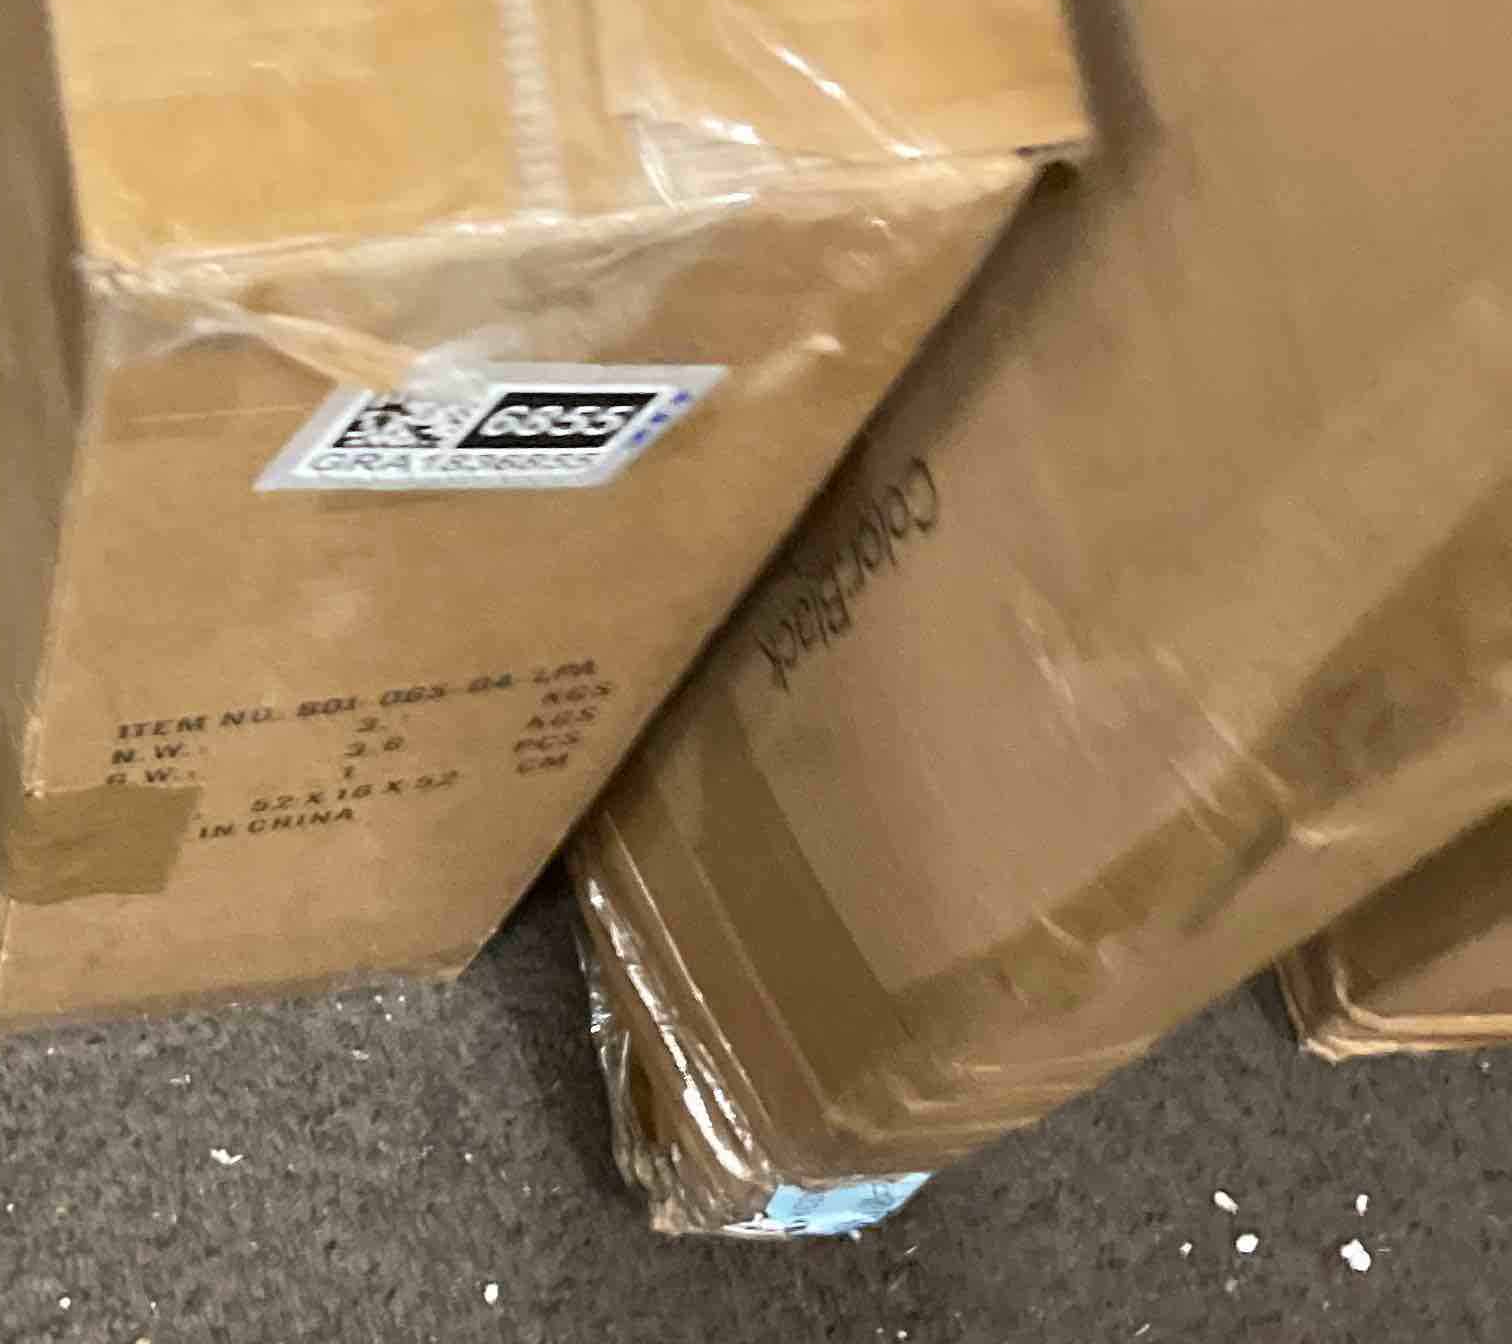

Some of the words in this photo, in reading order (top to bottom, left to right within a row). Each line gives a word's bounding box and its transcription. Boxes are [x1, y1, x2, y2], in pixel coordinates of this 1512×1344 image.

[117, 714, 207, 739] ITEM
[198, 822, 235, 839] IN
[247, 807, 355, 834] CHINA
